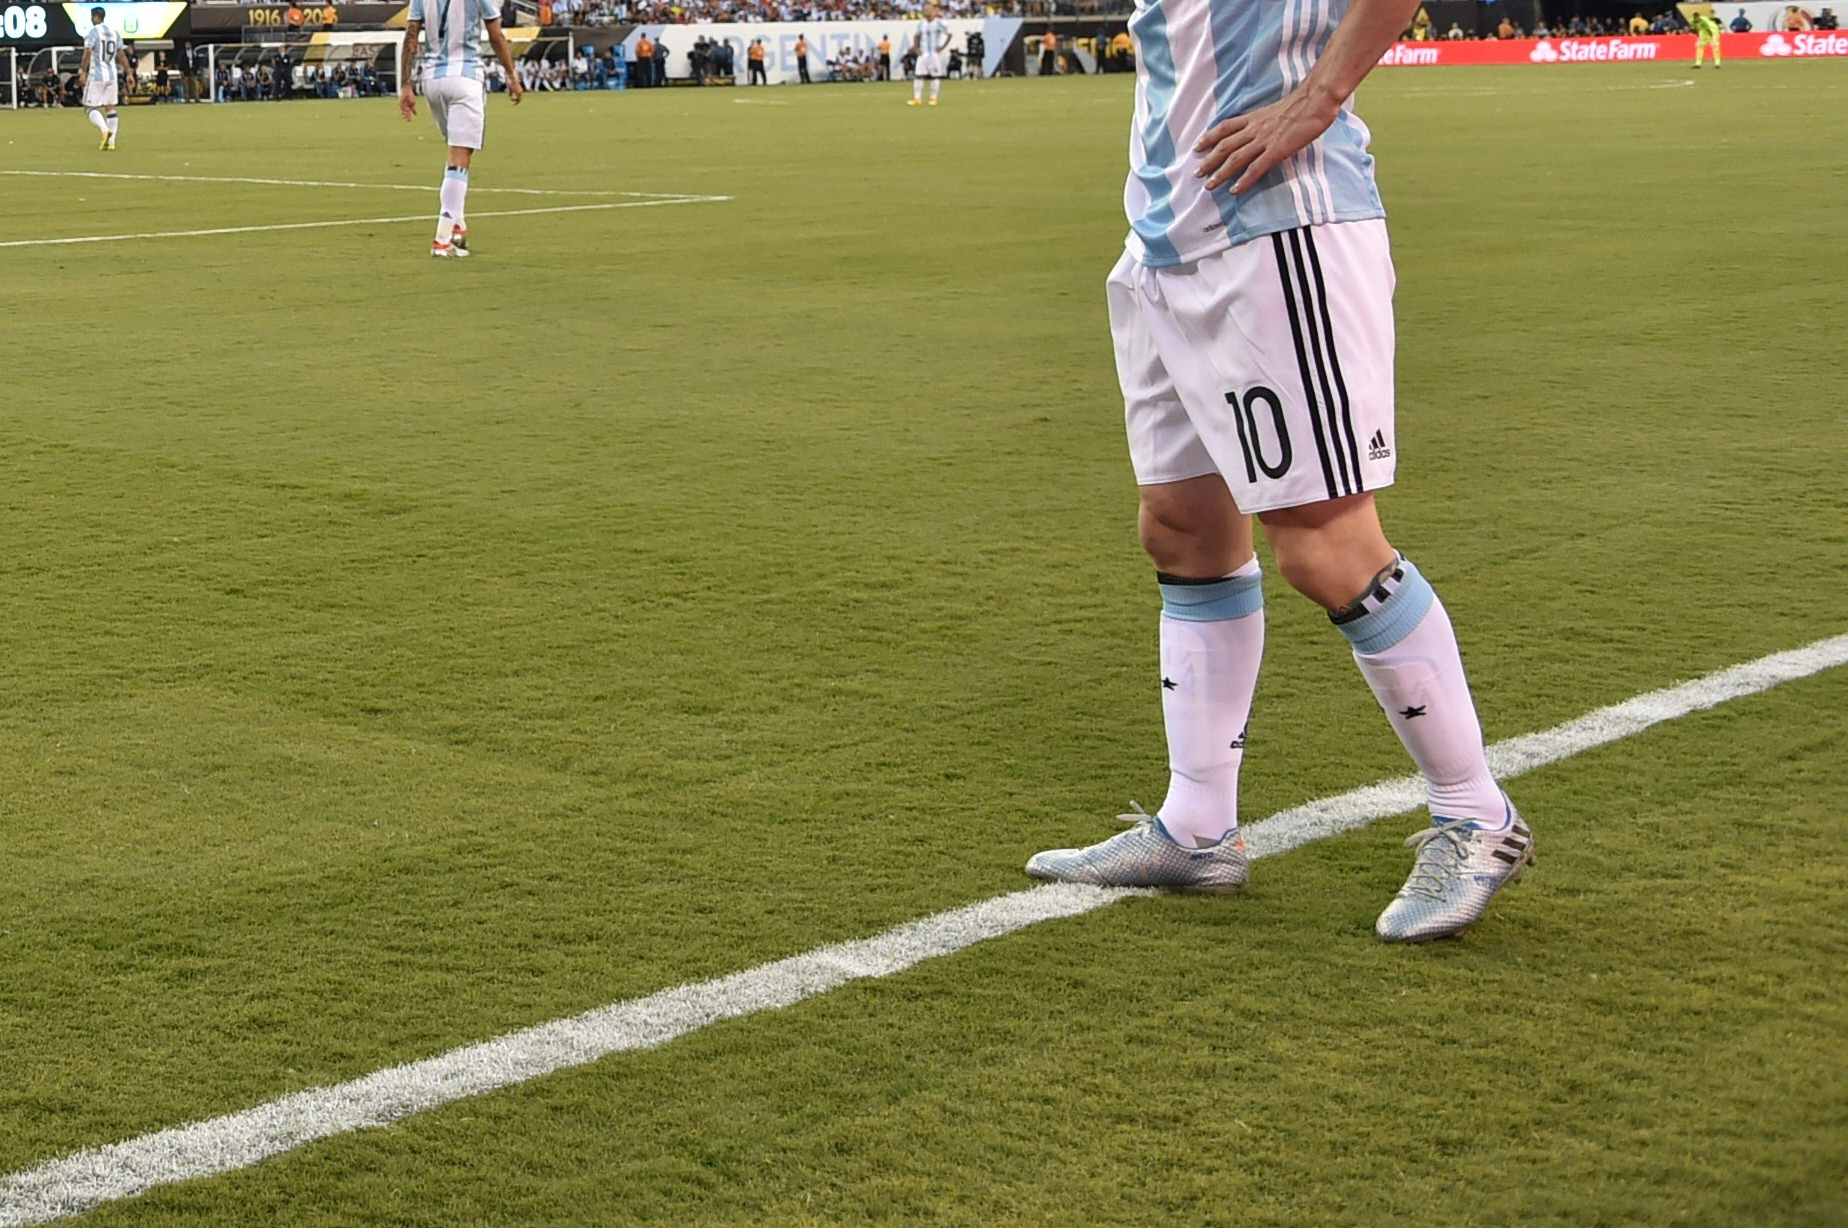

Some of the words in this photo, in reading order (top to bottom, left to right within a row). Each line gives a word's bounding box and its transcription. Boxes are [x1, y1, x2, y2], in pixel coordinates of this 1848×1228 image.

[248, 9, 281, 26] 1916
[101, 40, 116, 62] 19
[1224, 386, 1293, 483] 10
